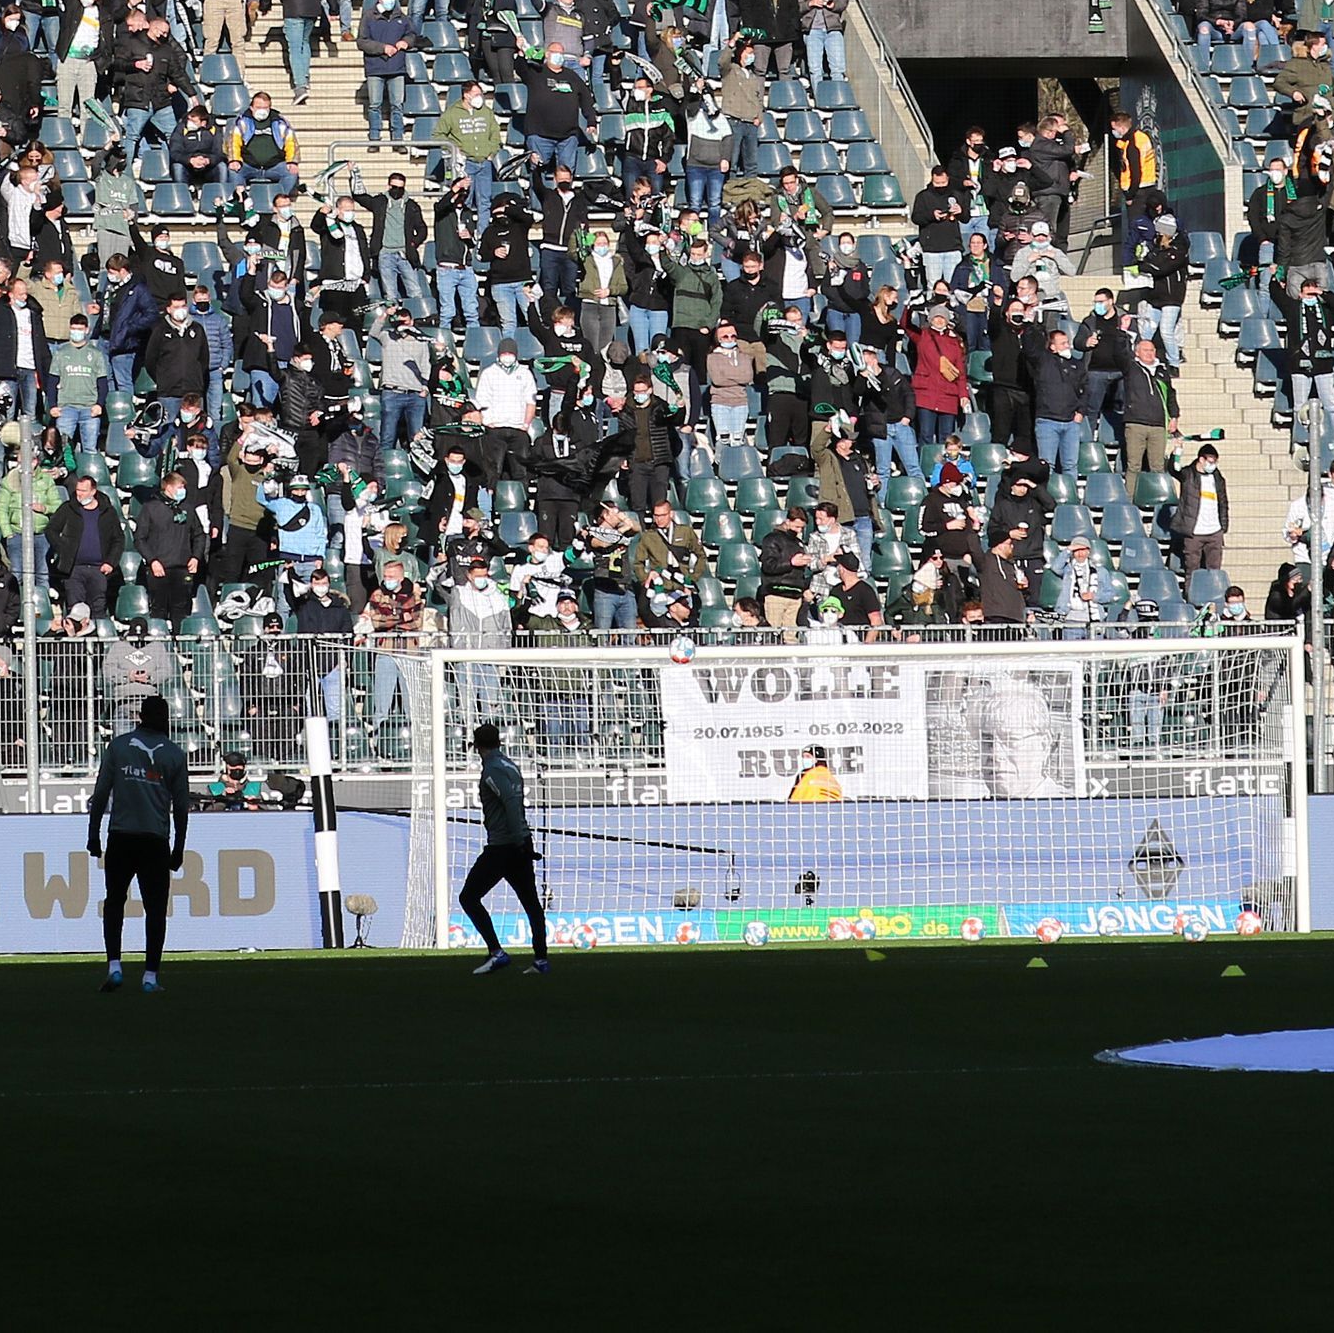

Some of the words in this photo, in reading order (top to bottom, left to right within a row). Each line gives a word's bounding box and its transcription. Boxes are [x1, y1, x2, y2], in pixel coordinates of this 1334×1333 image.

[692, 664, 901, 704] WOLLE
[693, 723, 783, 740] 20.07.1955
[808, 721, 905, 737] 05.02.2022
[606, 777, 661, 806] fla
[23, 849, 276, 921] WRD
